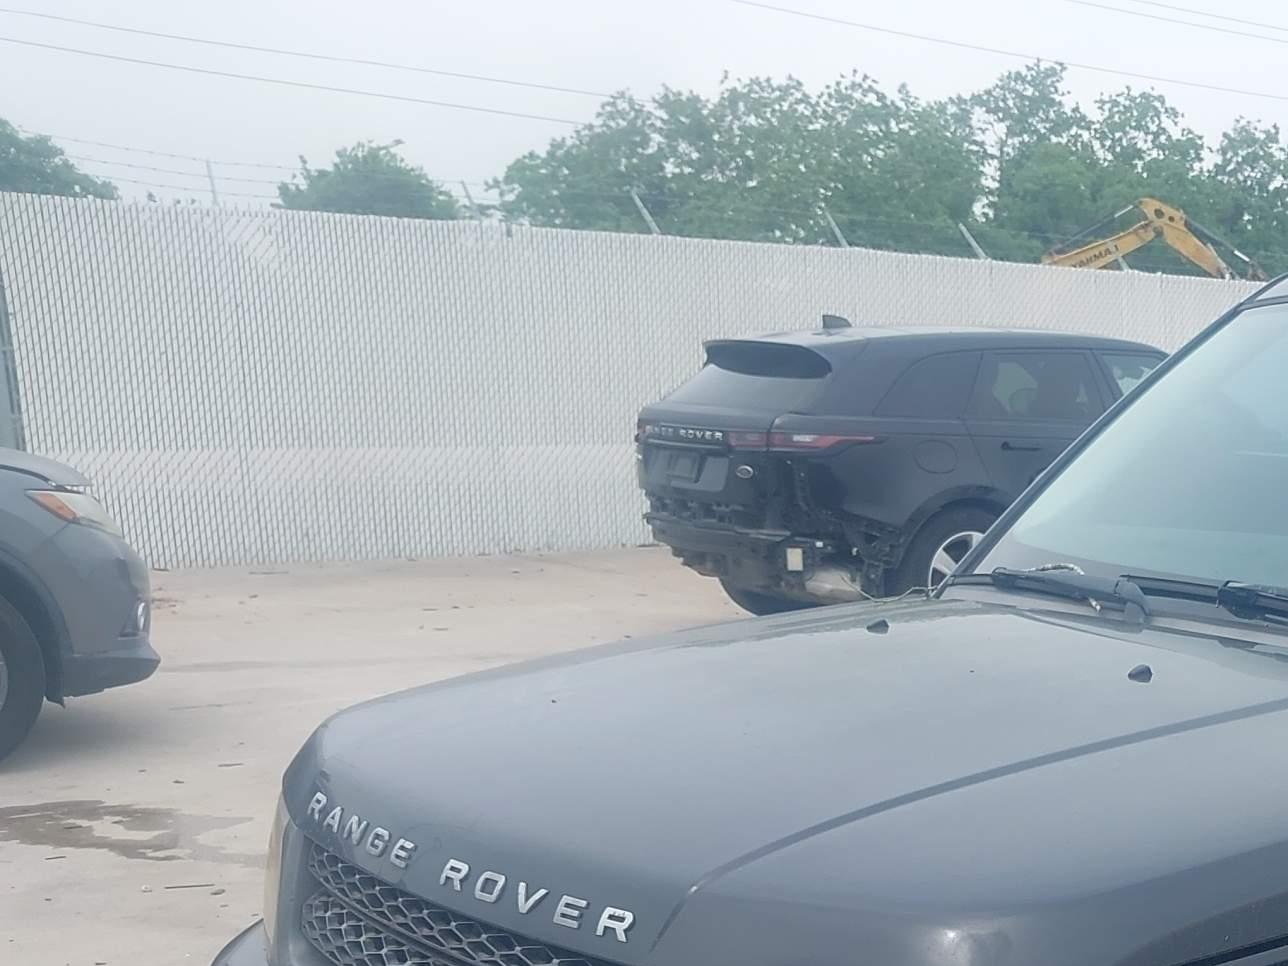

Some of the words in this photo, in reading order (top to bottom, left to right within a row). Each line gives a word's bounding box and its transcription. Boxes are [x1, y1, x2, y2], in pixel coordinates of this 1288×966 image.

[679, 429, 723, 441] ROVER
[307, 791, 417, 869] RANGE
[439, 858, 636, 943] ROVER
